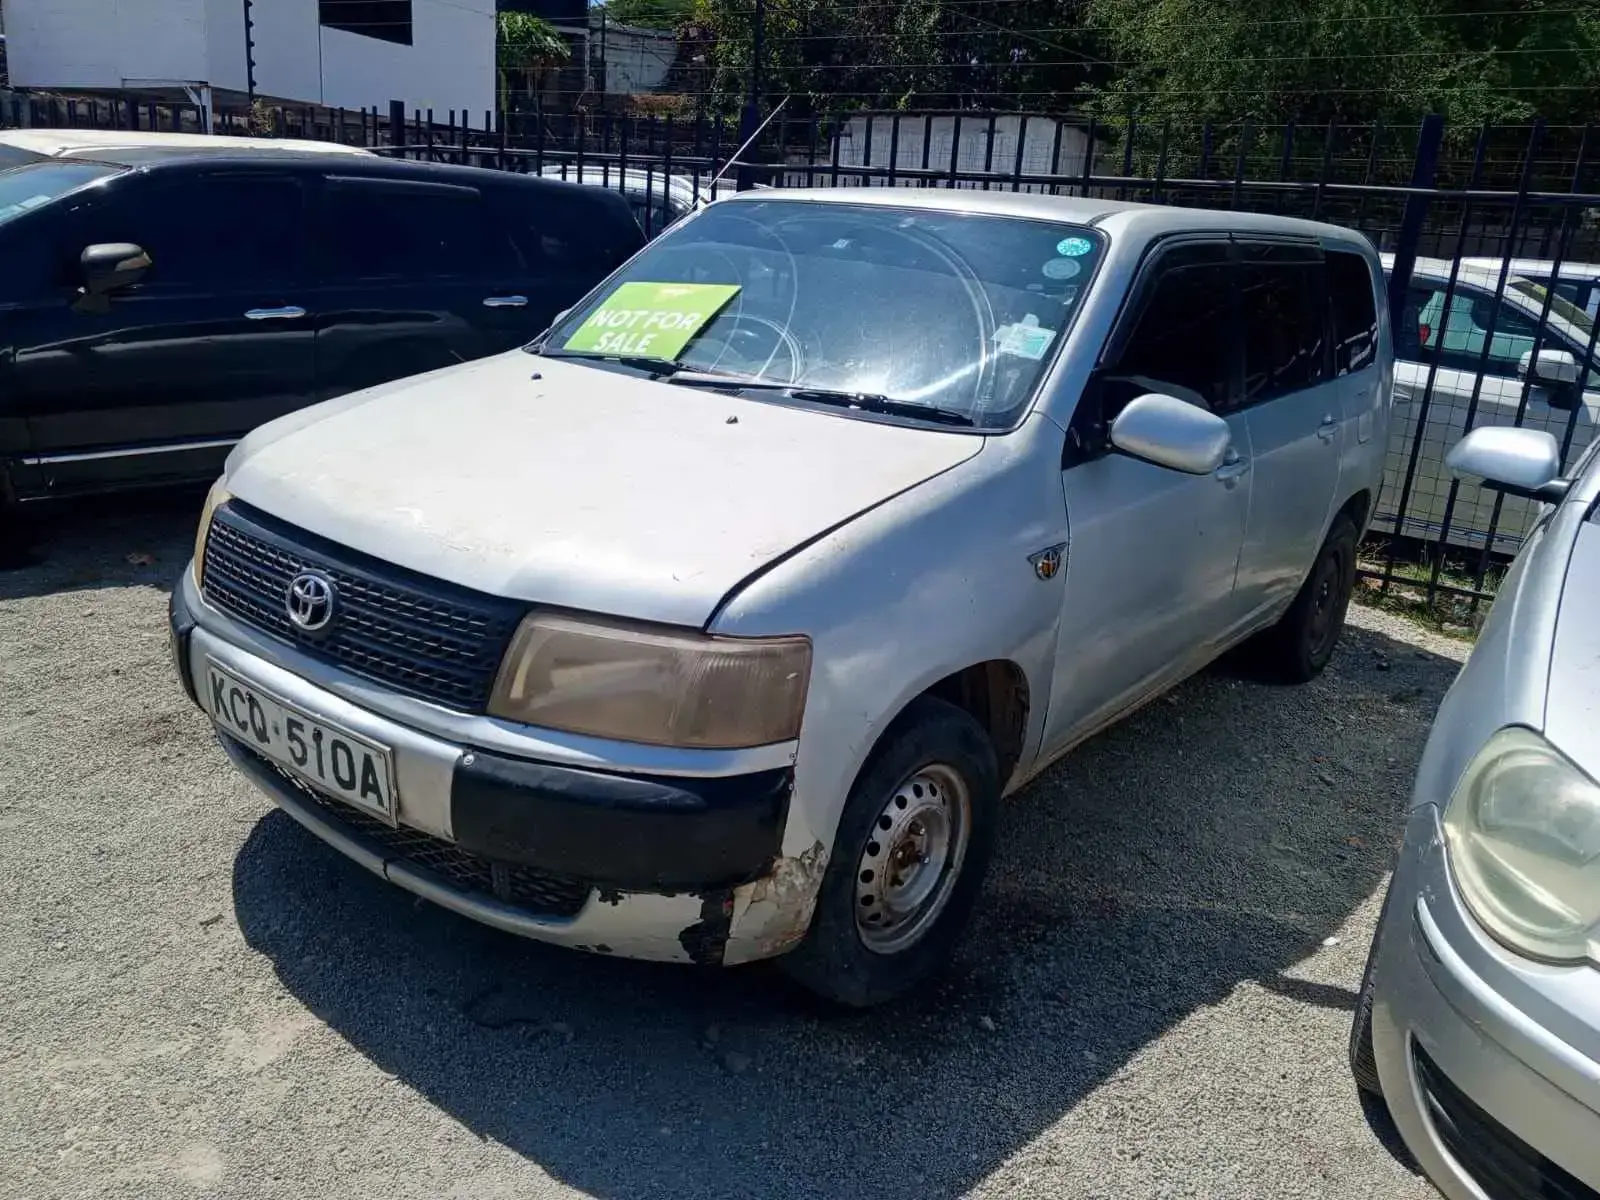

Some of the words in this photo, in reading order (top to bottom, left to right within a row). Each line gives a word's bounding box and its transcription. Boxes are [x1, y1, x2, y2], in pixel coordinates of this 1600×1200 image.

[589, 310, 649, 328] NOT
[644, 311, 700, 330] FOR
[594, 331, 658, 352] SALE
[287, 717, 385, 808] 510A
